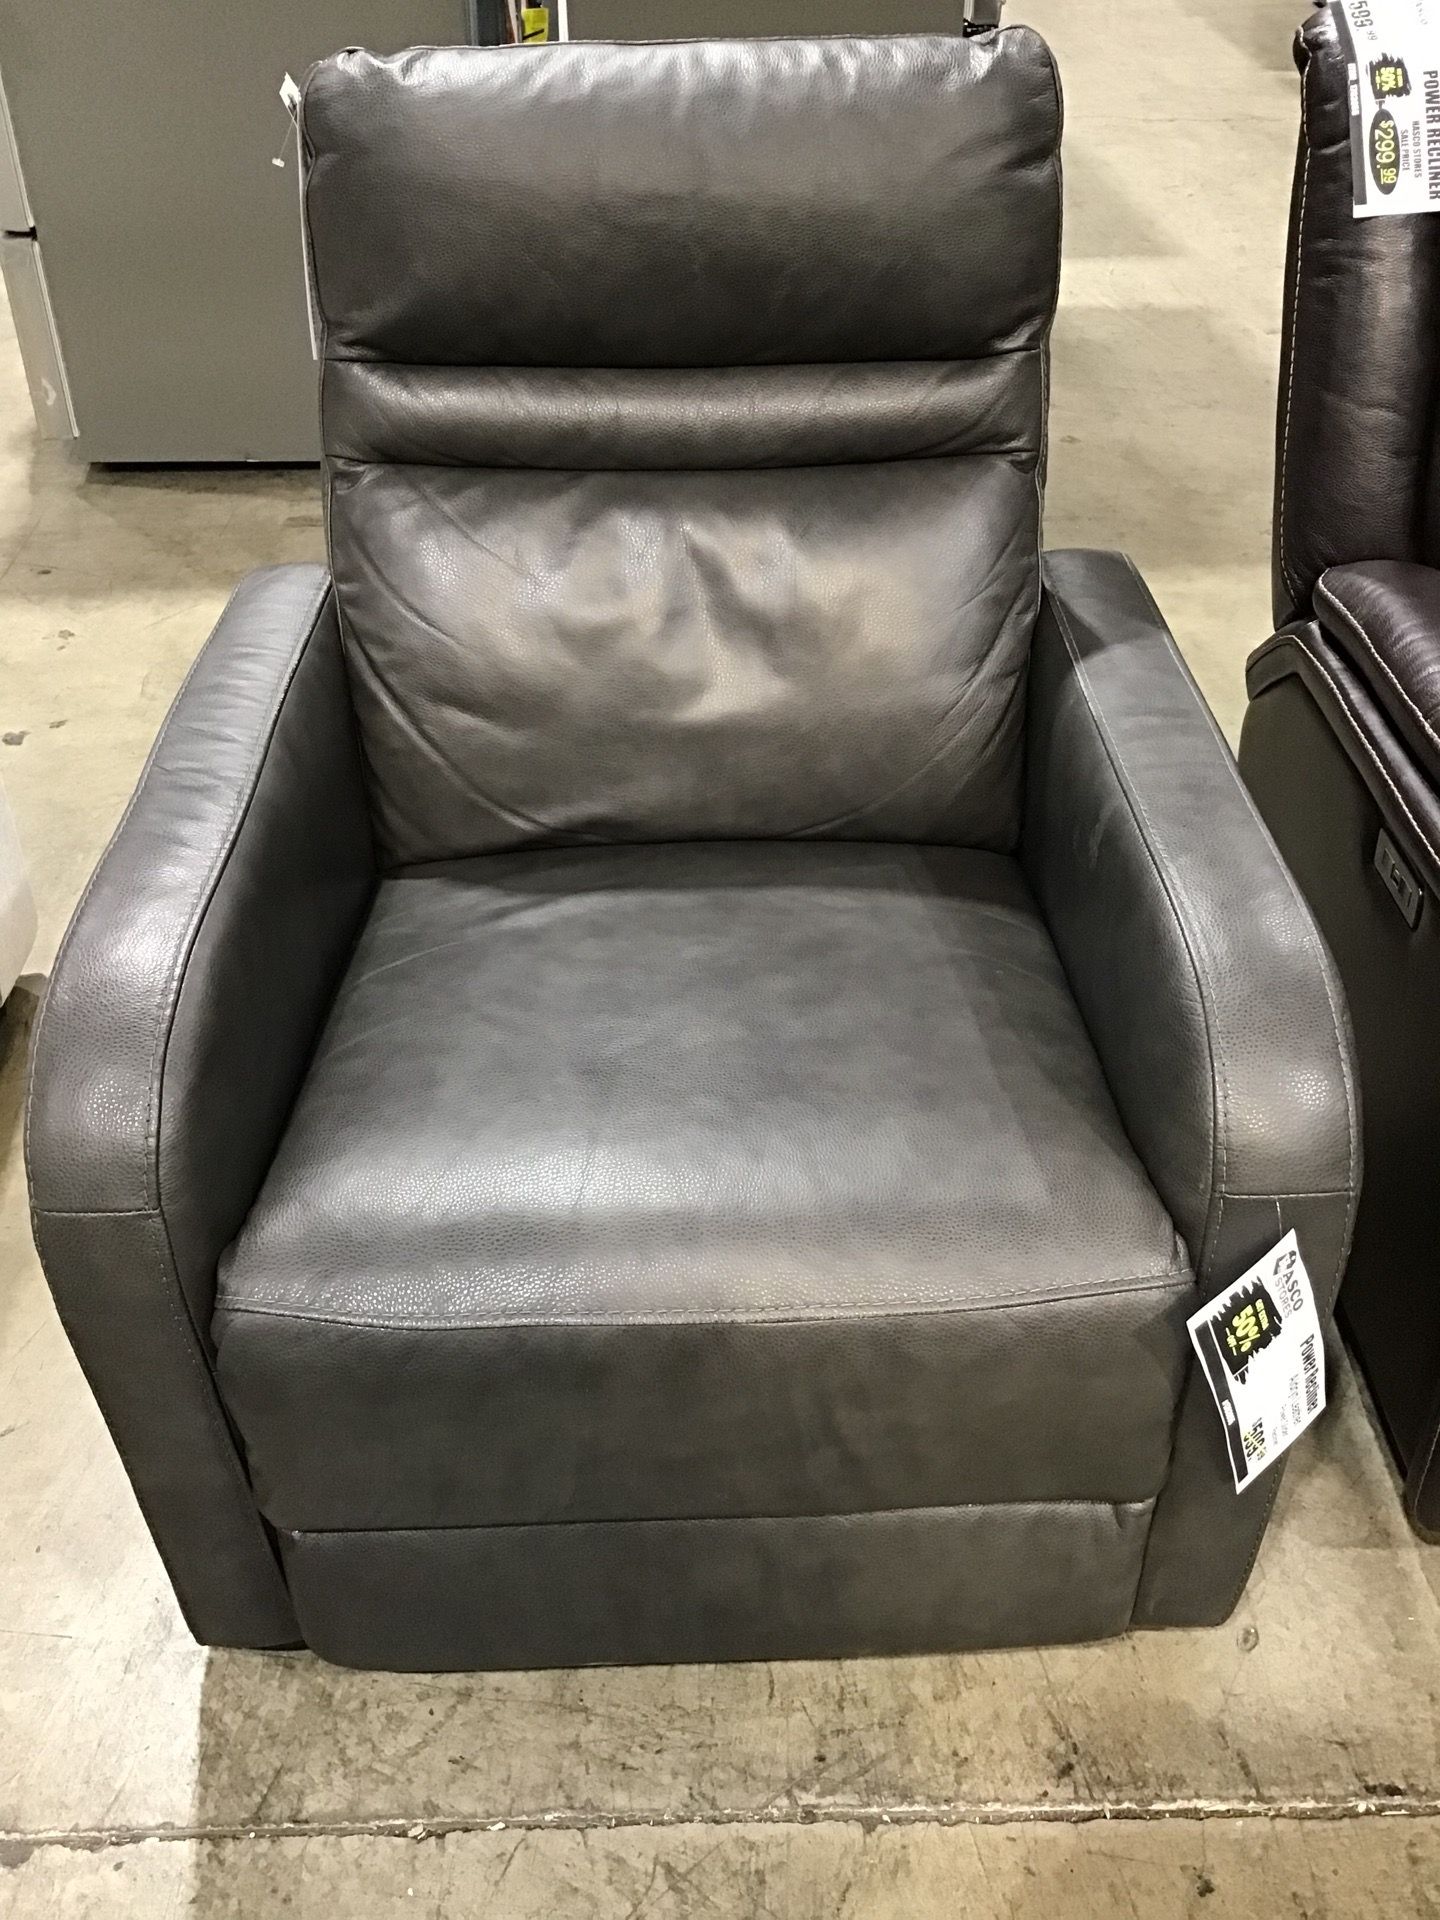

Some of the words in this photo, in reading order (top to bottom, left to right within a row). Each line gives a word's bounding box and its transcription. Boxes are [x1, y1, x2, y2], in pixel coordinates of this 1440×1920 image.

[1423, 70, 1440, 124] POWER
[1400, 129, 1410, 147] SALE
[1402, 149, 1411, 171] PRICE
[1412, 149, 1422, 178] STORES
[1426, 128, 1440, 199] RECLINER
[1274, 1277, 1293, 1319] STORES
[1232, 1304, 1261, 1353] 50%
[1300, 1333, 1316, 1375] Power
[1304, 1367, 1320, 1415] Recliner
